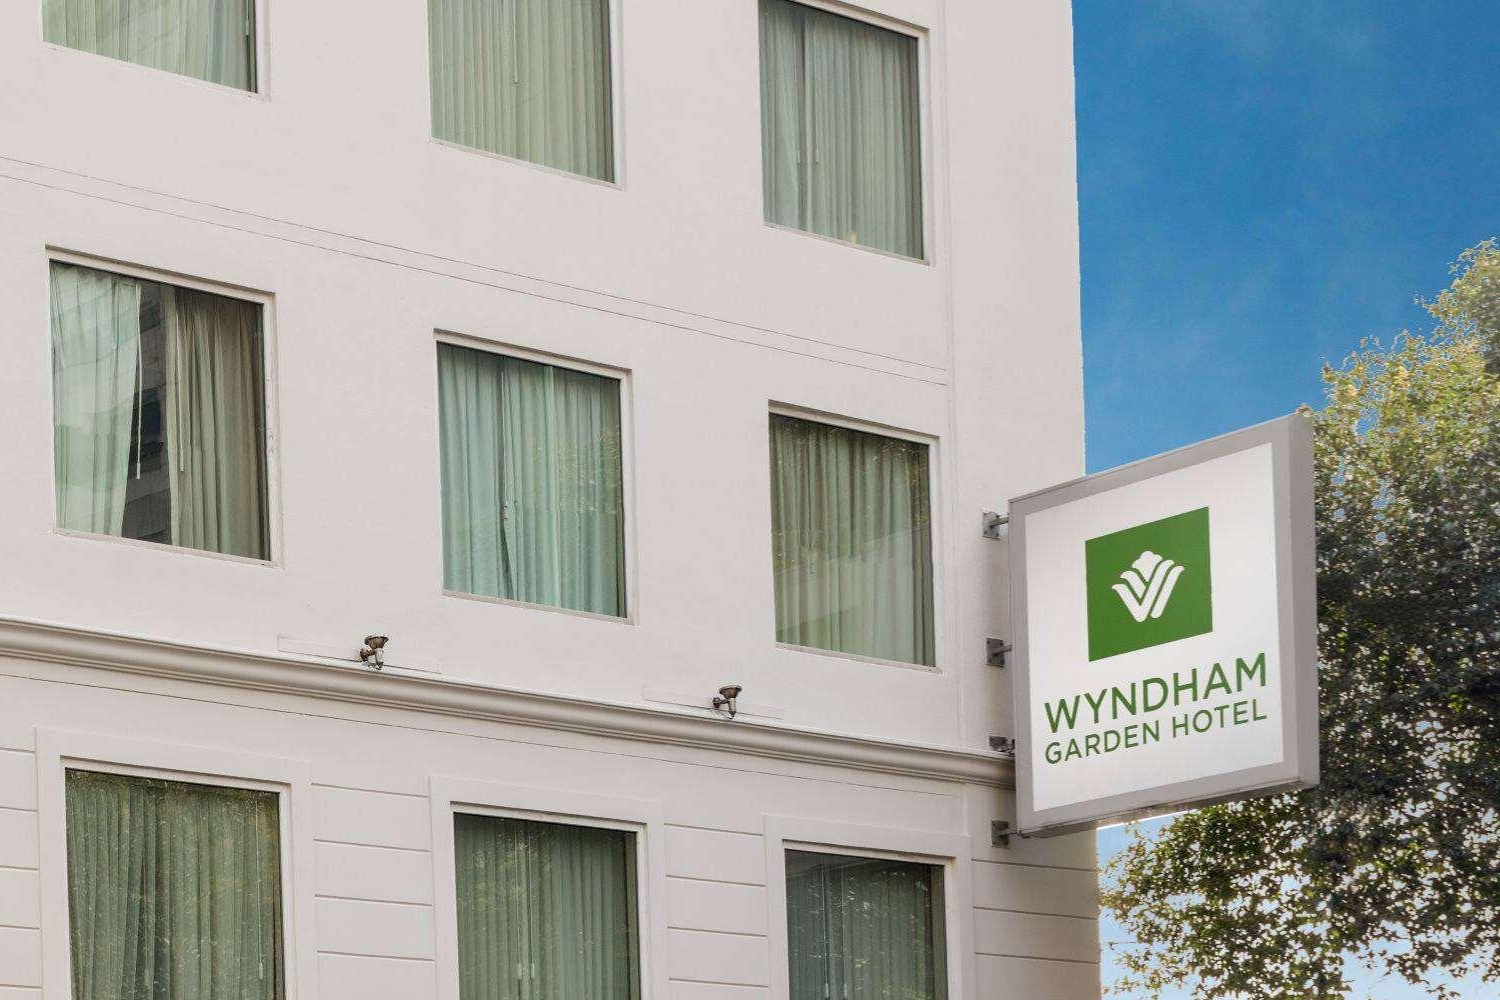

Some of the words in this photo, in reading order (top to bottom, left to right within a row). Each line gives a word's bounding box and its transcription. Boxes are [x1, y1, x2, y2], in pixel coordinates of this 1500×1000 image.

[1044, 653, 1267, 733] WYNDHAM
[1045, 720, 1160, 765] GARDEN
[1172, 699, 1267, 738] HOTEL
